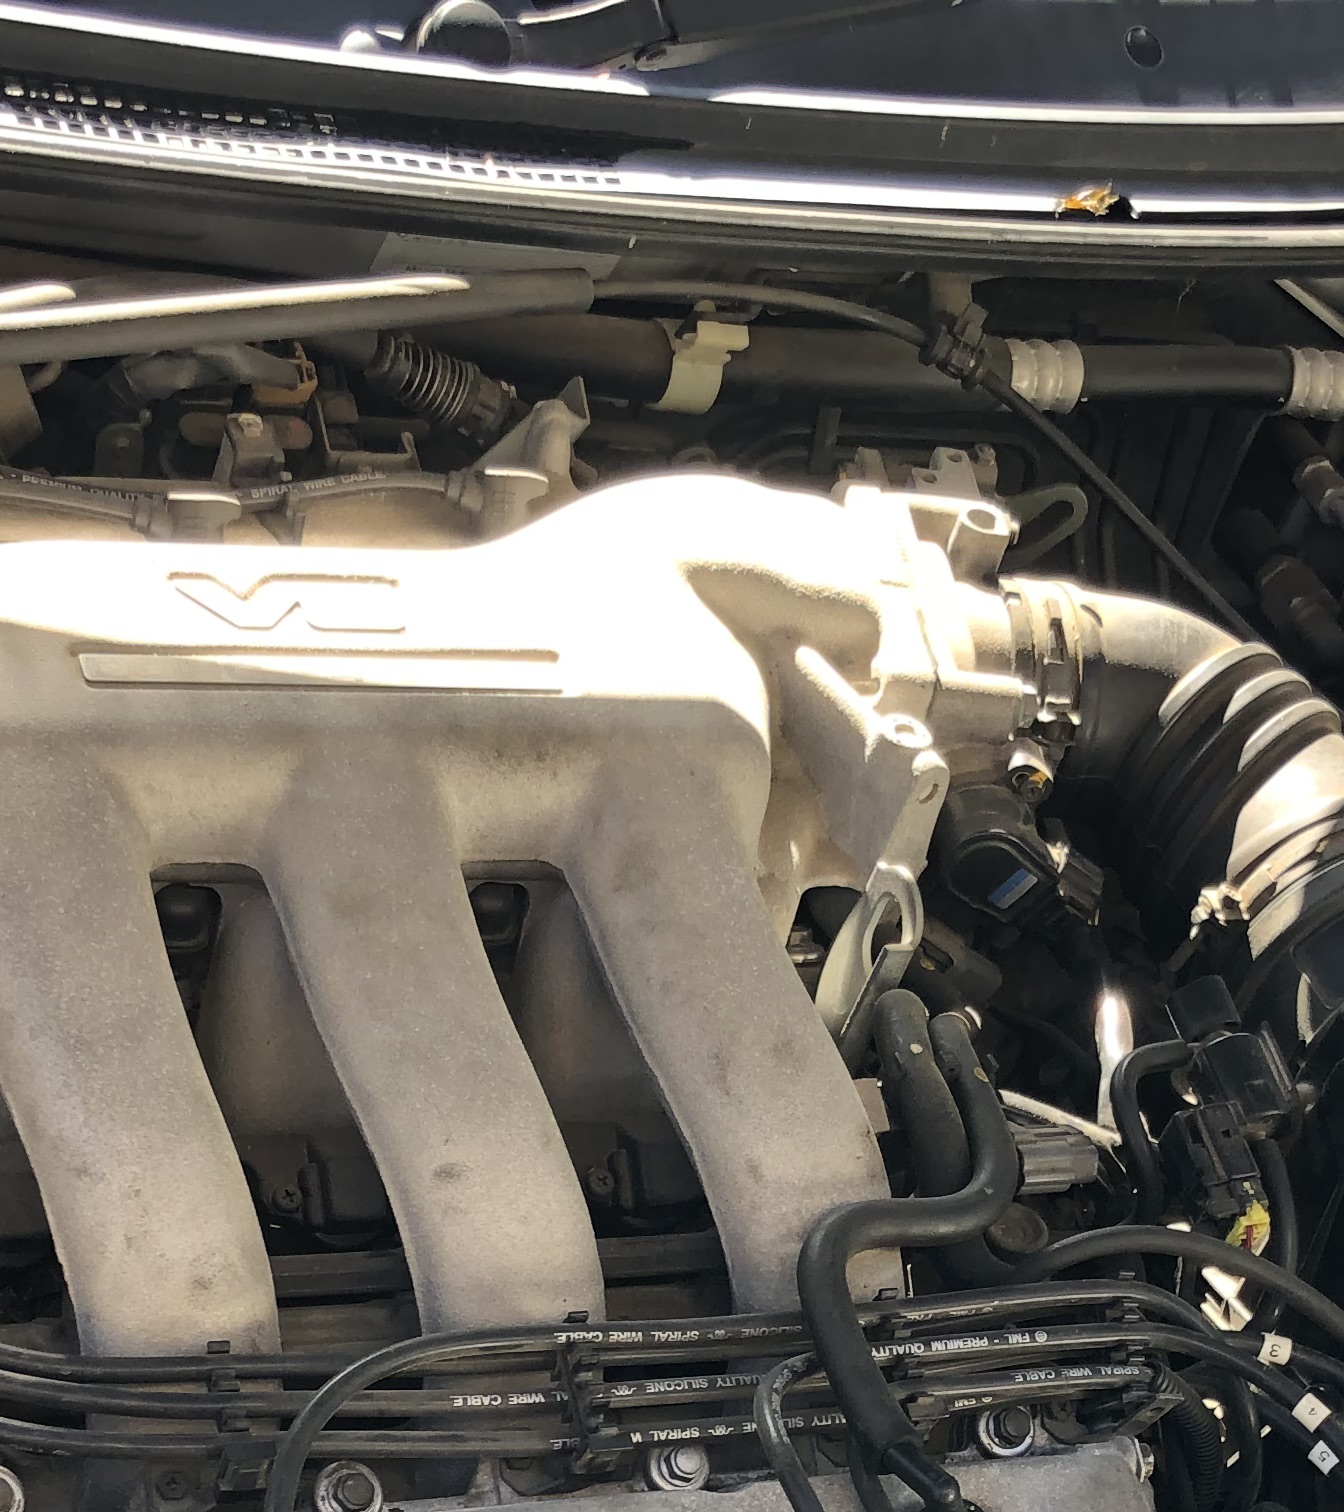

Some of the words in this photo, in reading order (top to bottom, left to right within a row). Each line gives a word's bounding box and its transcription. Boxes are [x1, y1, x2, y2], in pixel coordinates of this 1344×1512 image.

[608, 1331, 644, 1343] WIRE
[650, 1330, 700, 1342] SPIRAL
[1004, 1331, 1031, 1344] FML
[870, 1342, 925, 1357] QUALITY
[931, 1336, 989, 1352] PREMIUM
[1269, 1343, 1282, 1358] 3
[1097, 1365, 1140, 1377] SPIRAL
[645, 1378, 709, 1393] SILICONE
[508, 1392, 546, 1405] WIRE
[649, 1426, 700, 1441] SPIRAL
[1317, 1450, 1331, 1463] 5
